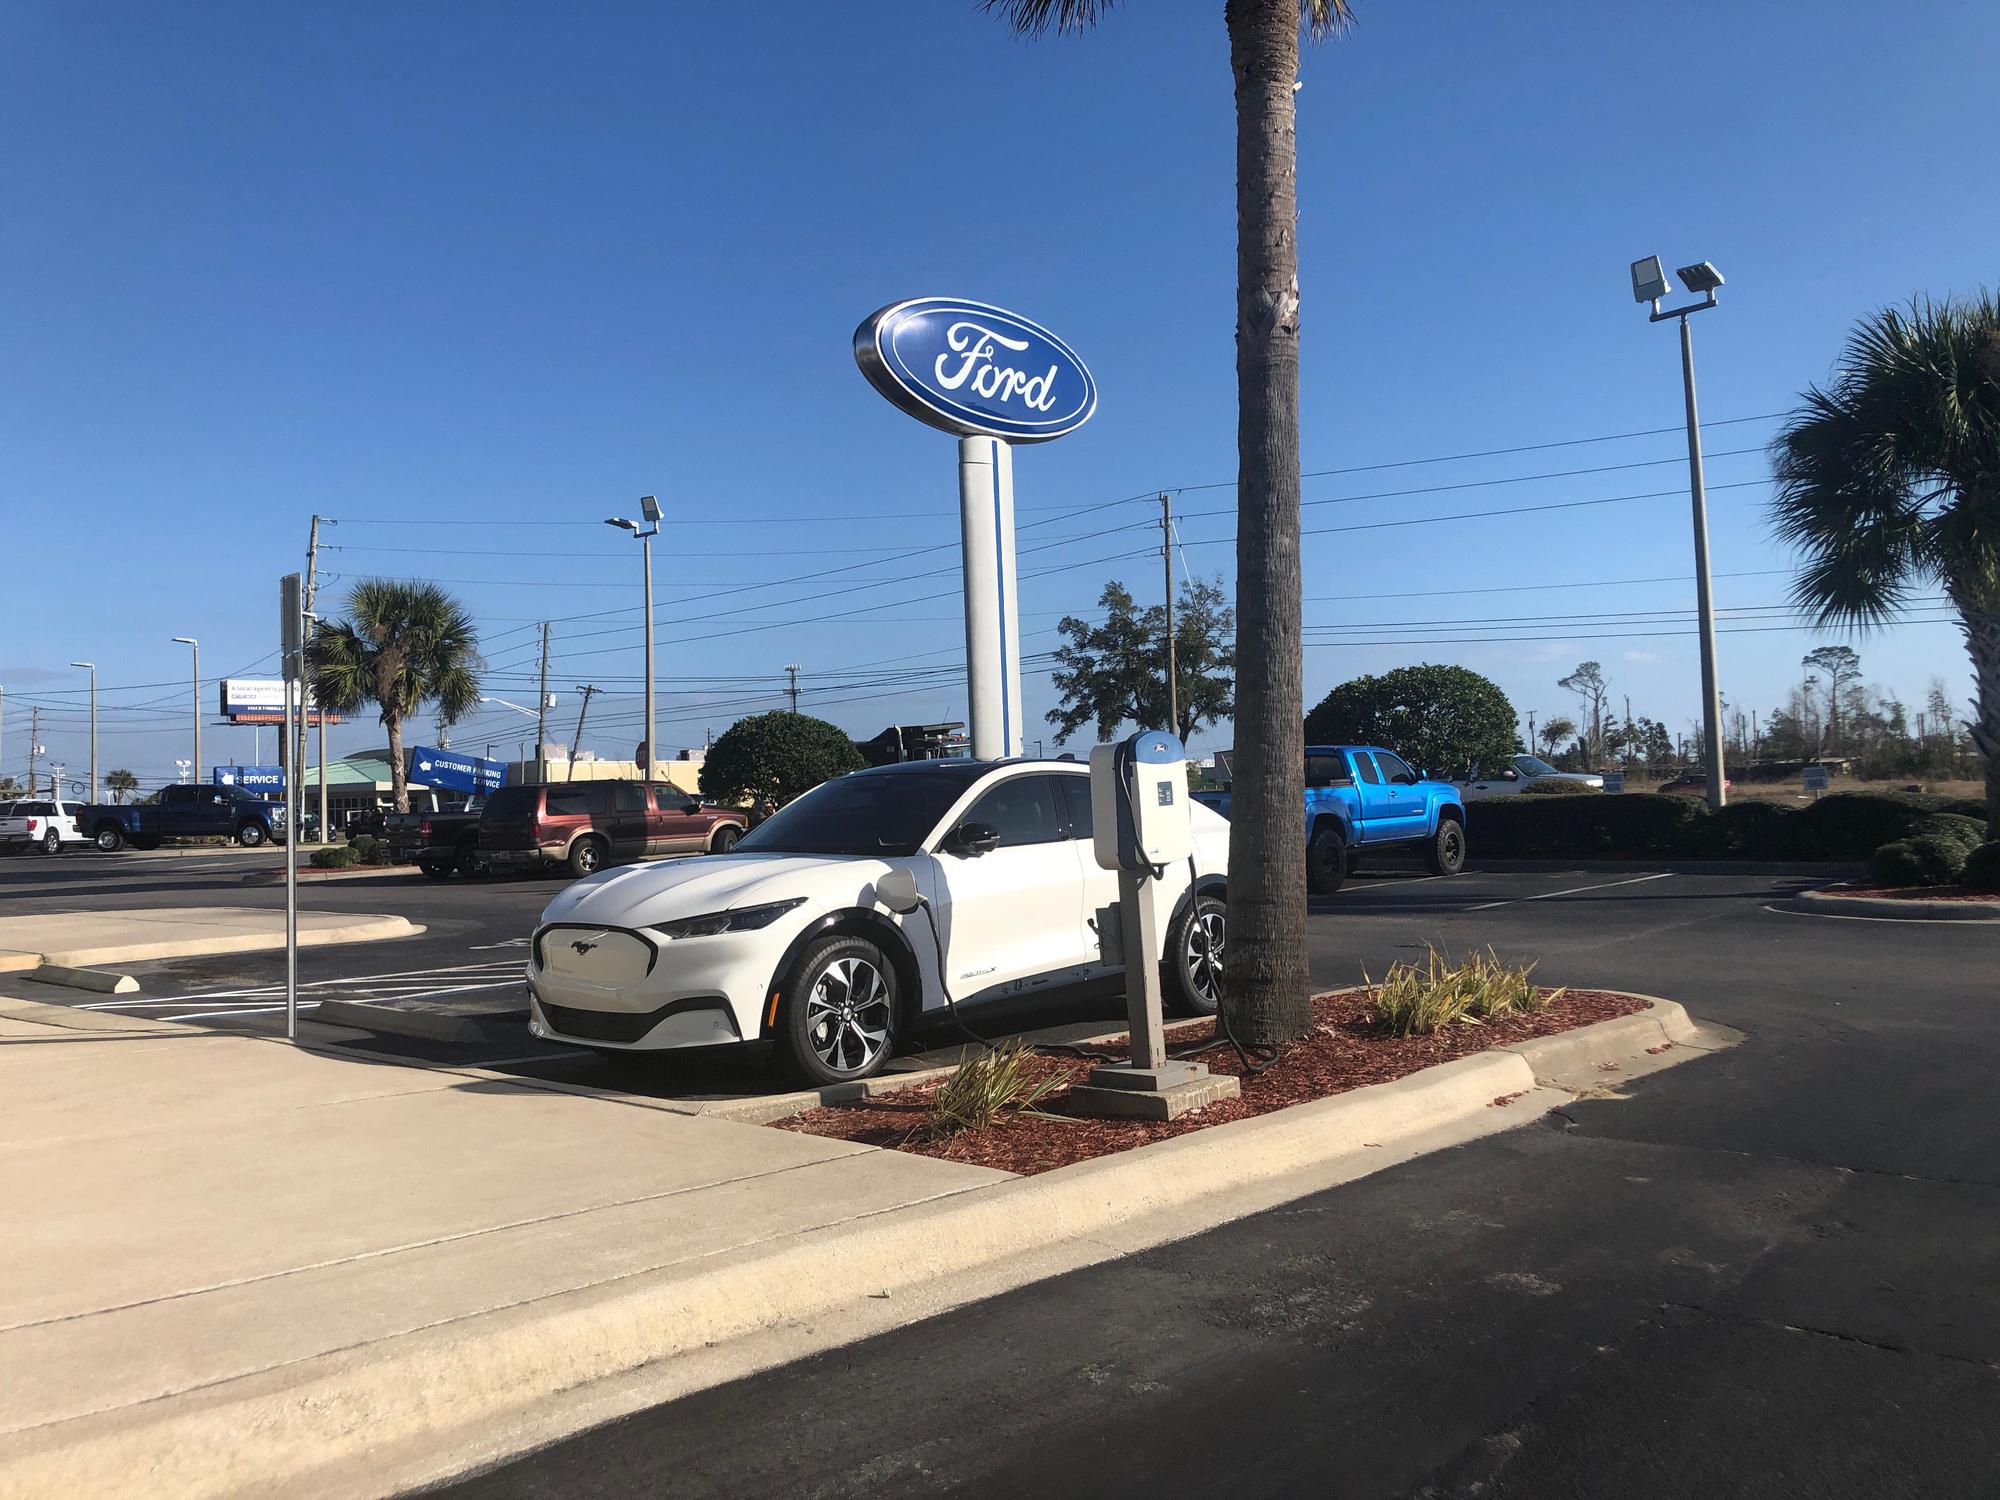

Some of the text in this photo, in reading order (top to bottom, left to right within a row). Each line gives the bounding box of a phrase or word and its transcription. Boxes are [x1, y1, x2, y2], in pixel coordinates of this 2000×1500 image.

[935, 322, 1058, 412] Ford
[434, 760, 501, 779] CUSTOMER PARKING
[236, 775, 278, 784] SERVICE
[473, 777, 500, 788] SERVICE
